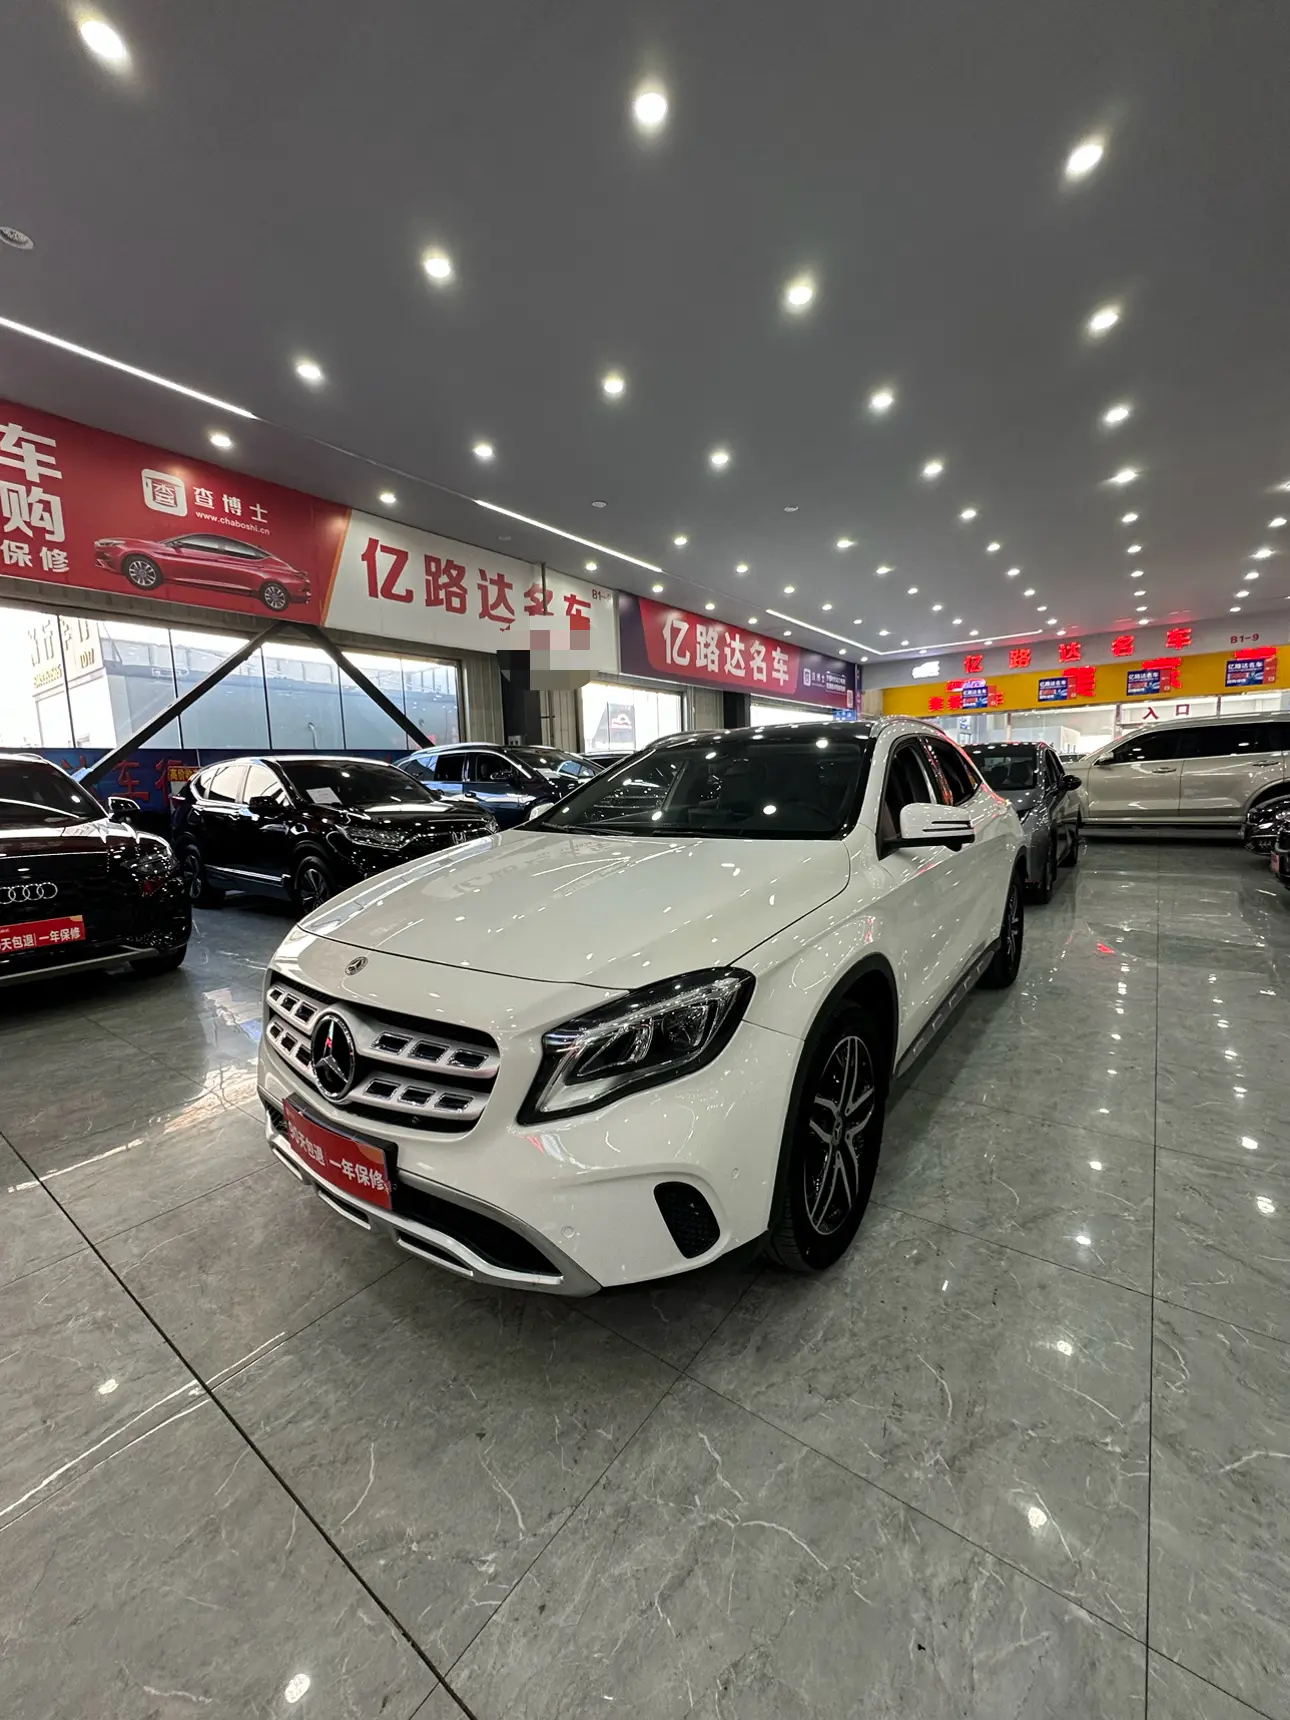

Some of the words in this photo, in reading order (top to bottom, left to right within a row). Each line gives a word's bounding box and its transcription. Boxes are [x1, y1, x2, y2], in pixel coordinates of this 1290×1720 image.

[0, 423, 63, 483] 车
[0, 480, 66, 542] 购
[192, 486, 268, 523] 查博士
[195, 511, 271, 535] www.chaboshi.cn
[1, 539, 70, 573] 保修
[662, 613, 790, 687] 亿路达名车
[963, 627, 1193, 675] 亿路达名车
[1230, 633, 1260, 645] B1-9
[1143, 703, 1190, 721] 入口
[38, 926, 81, 943] 一年保修
[329, 1158, 390, 1195] 一年保修
